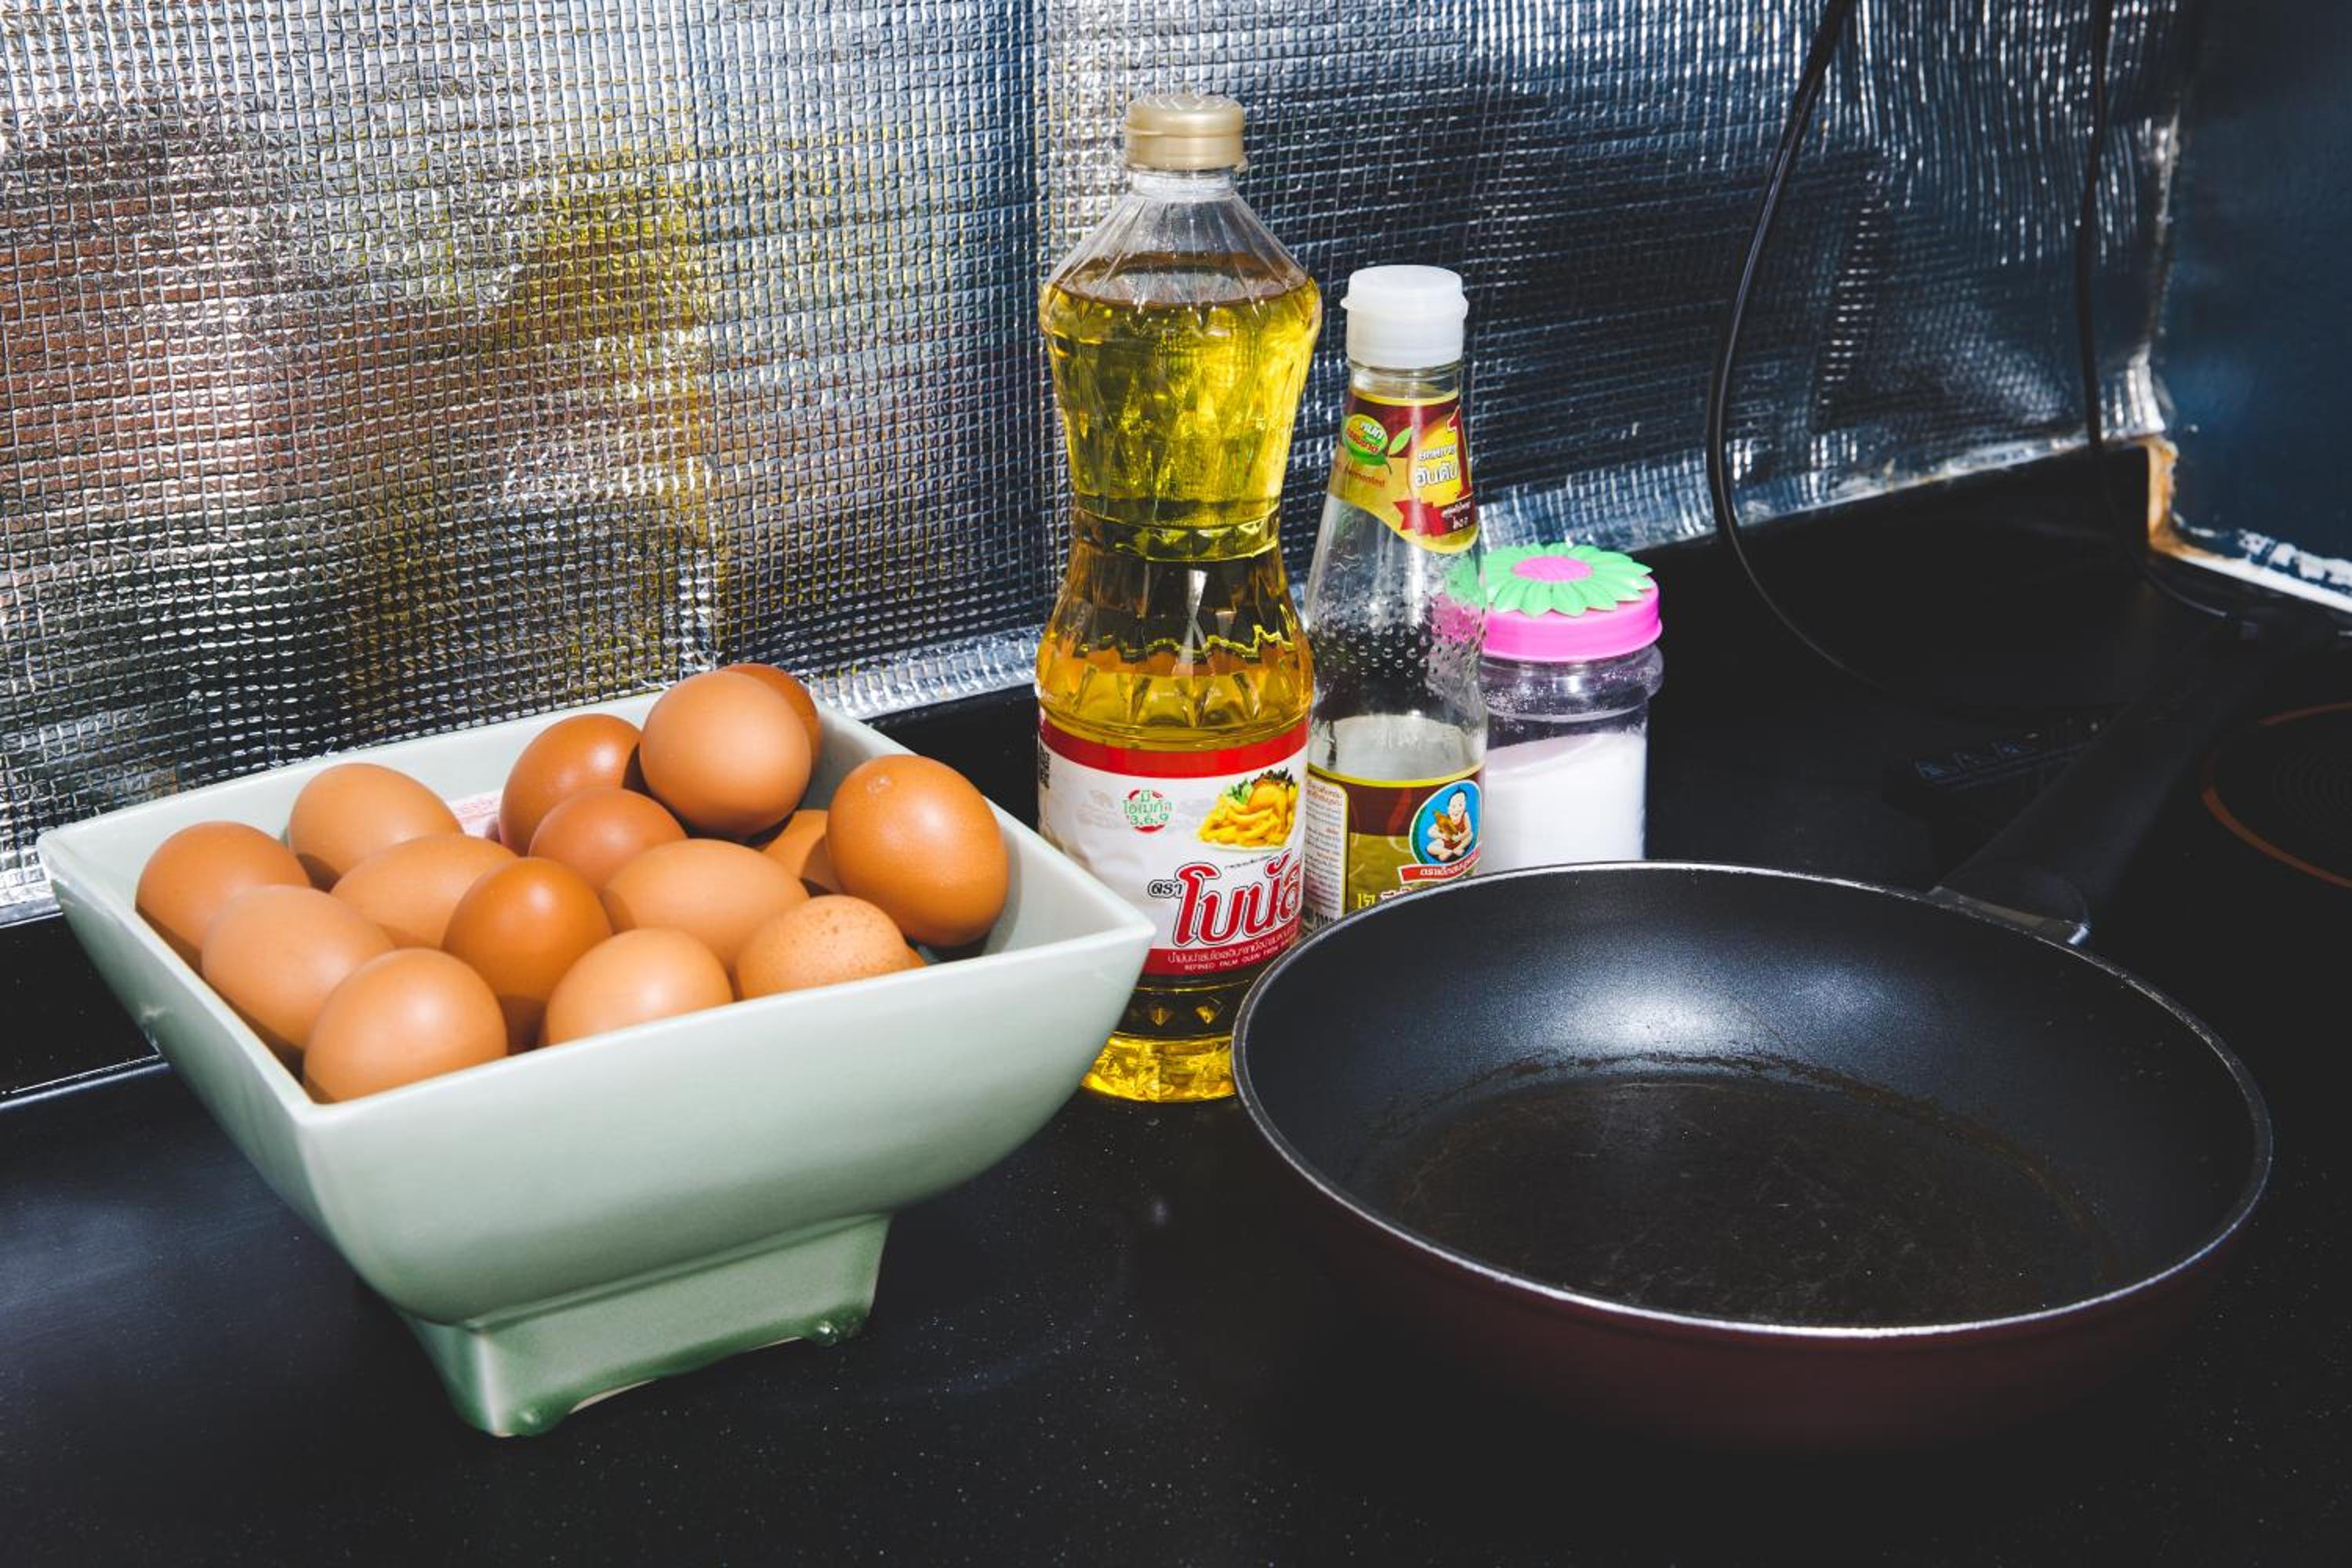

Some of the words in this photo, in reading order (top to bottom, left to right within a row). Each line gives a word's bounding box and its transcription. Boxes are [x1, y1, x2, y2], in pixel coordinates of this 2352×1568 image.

[1447, 405, 1472, 499] 1
[1415, 463, 1458, 487] อันดับ
[1149, 881, 1183, 896] ตรา
